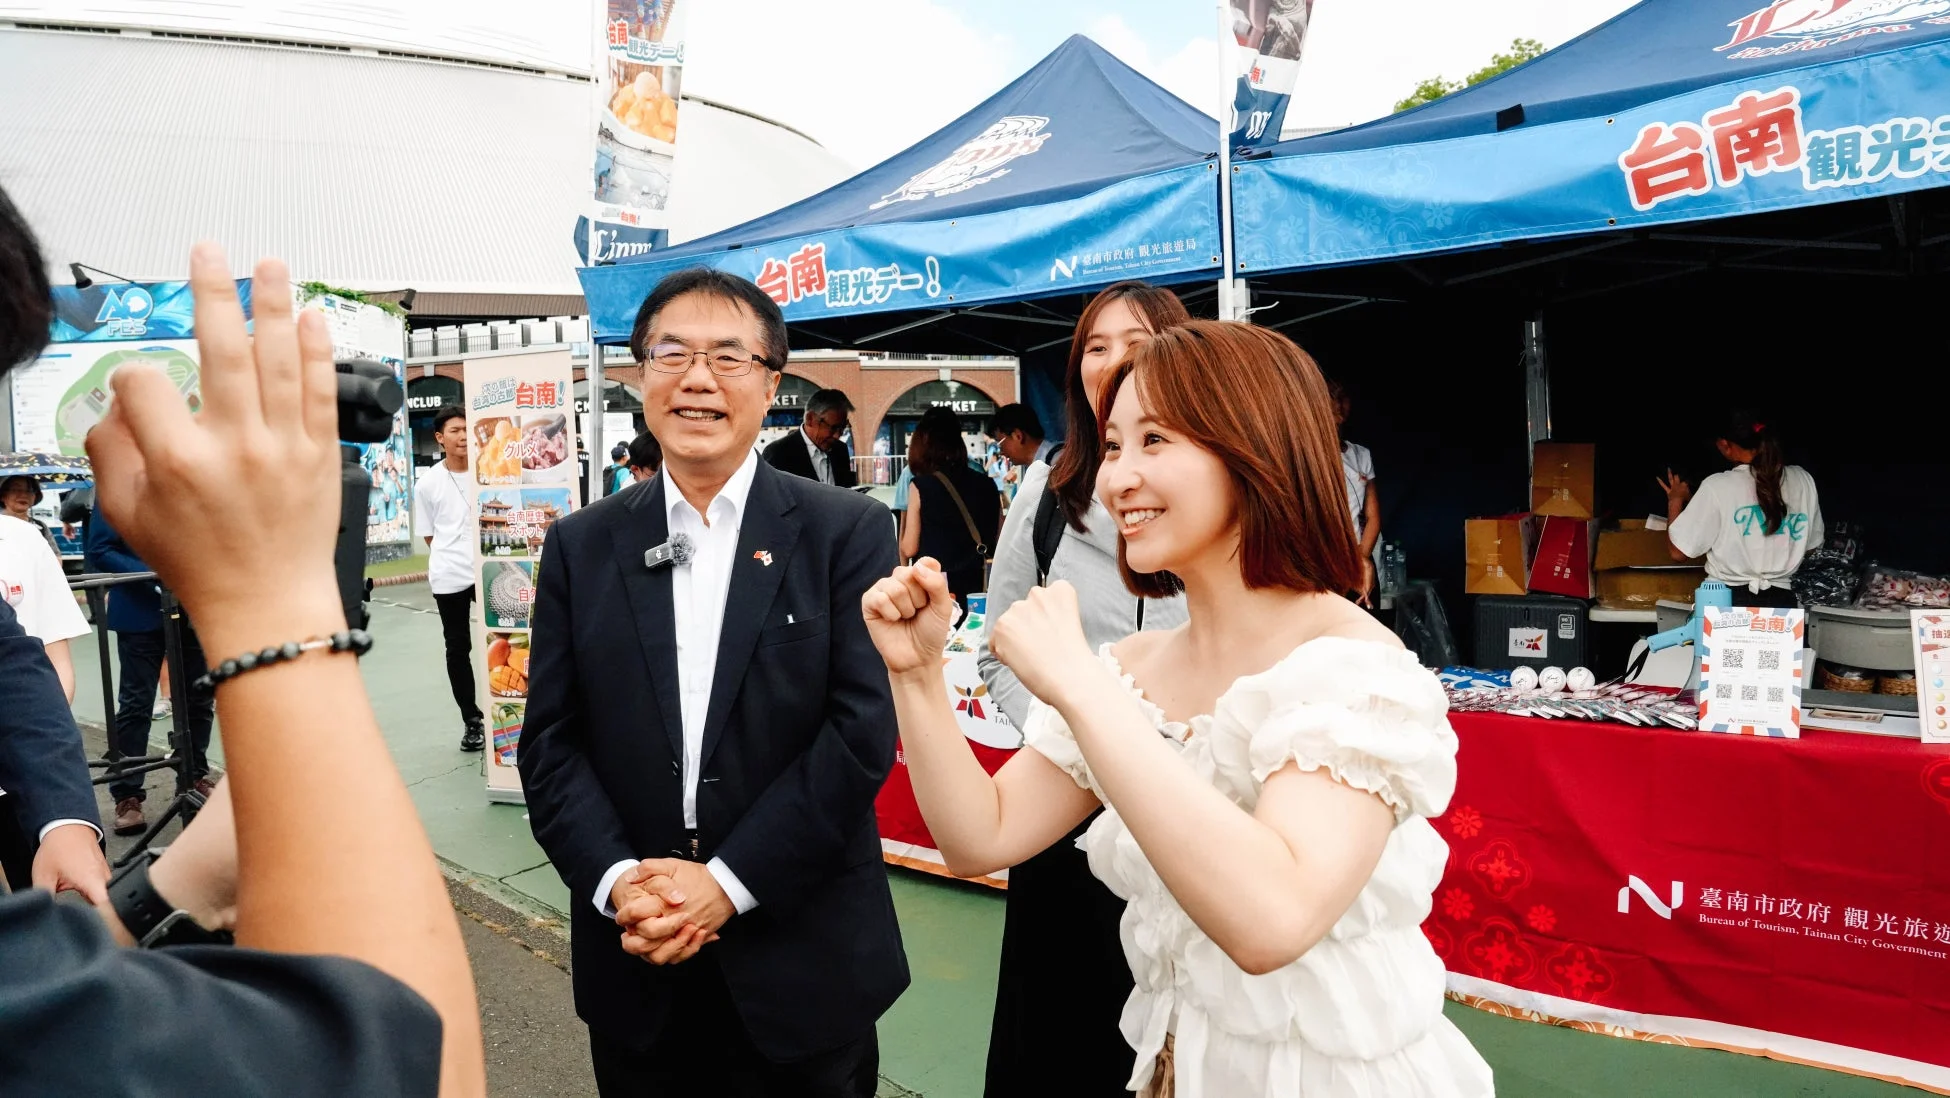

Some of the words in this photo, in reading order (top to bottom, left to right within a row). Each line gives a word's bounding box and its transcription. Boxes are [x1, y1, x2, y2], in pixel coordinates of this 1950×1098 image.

[504, 442, 538, 459] グルメ
[1700, 887, 1831, 924] 臺南市政府
[1699, 913, 1735, 926] Bureau
[1737, 918, 1750, 928] of
[1752, 919, 1799, 935] Tourism,
[1802, 926, 1841, 941] Tainan
[1843, 933, 1869, 948] City
[1872, 938, 1948, 959] Government
